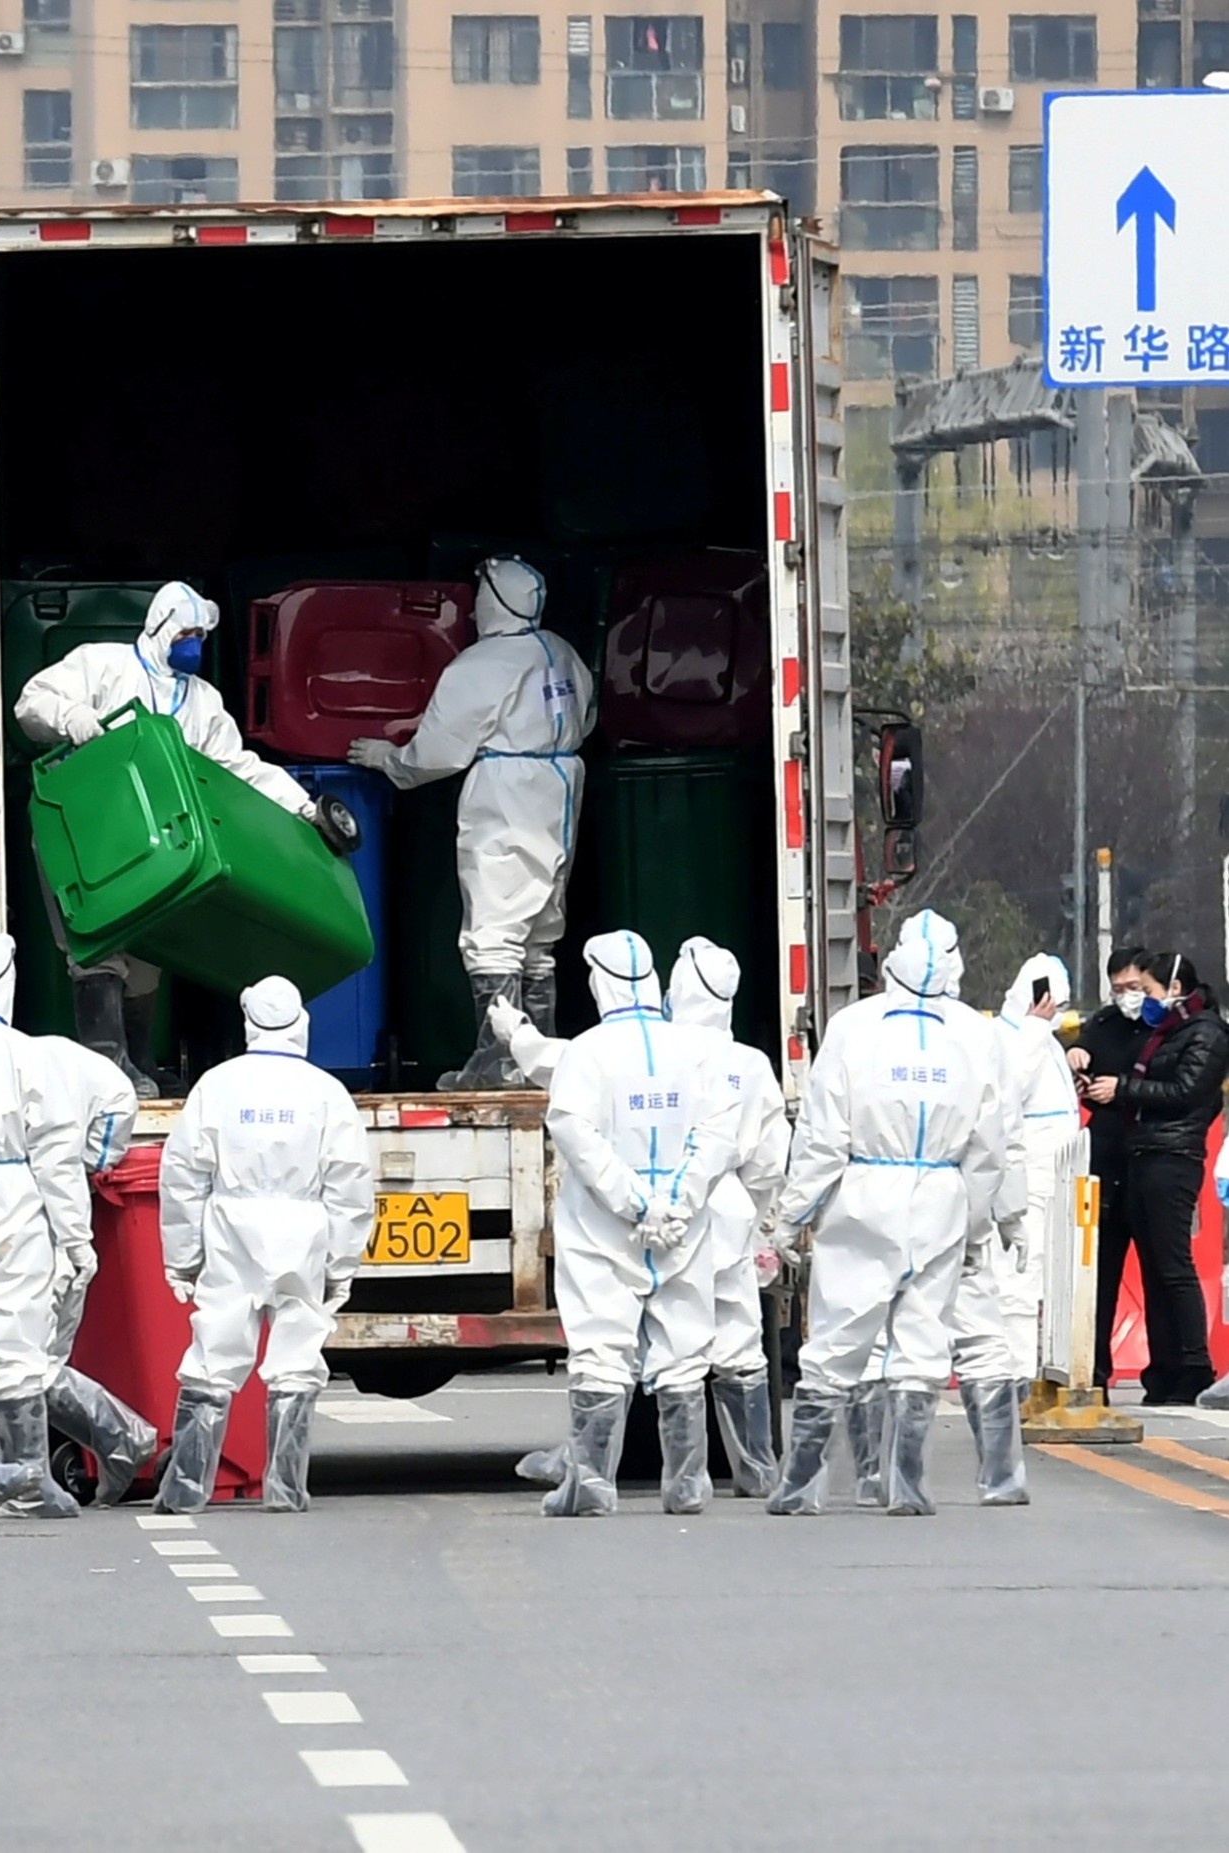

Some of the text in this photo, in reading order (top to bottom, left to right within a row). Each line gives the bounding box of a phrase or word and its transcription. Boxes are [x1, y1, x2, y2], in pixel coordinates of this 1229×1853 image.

[1060, 323, 1229, 373] 新华路
[628, 1092, 679, 1110] 搬运班
[240, 1109, 295, 1124] 搬运班
